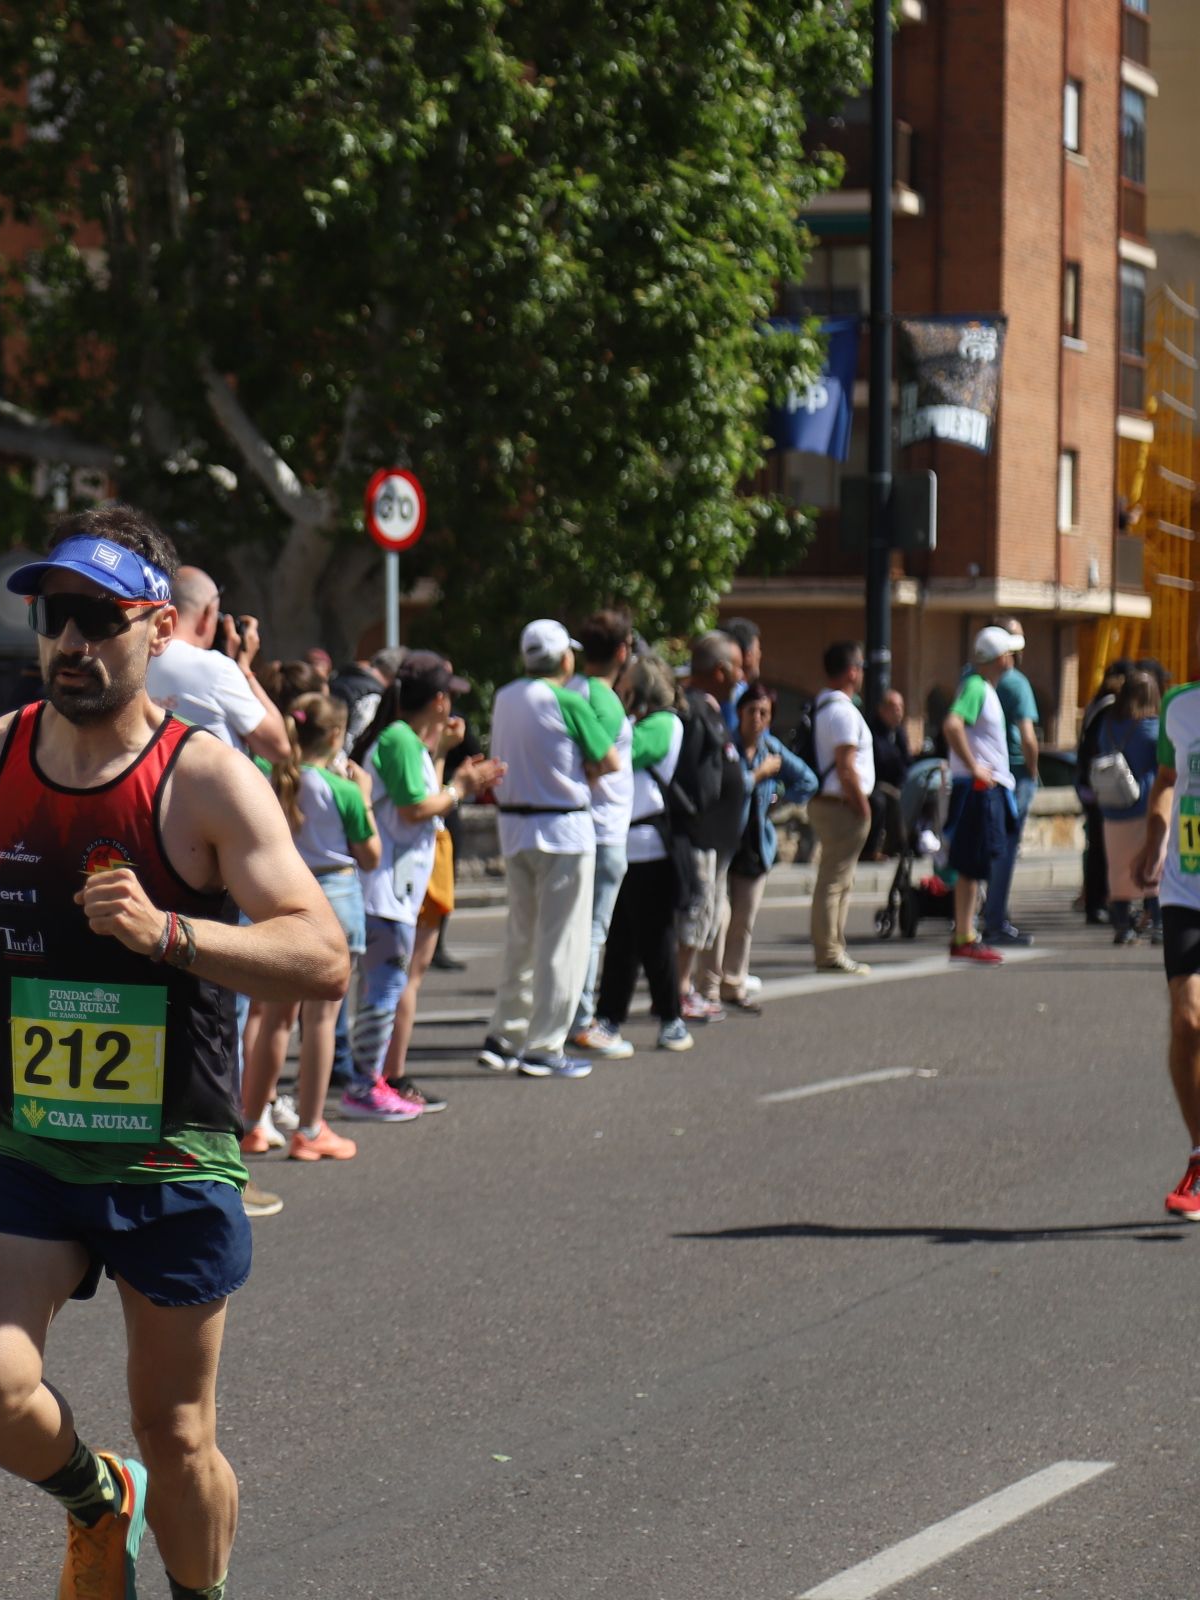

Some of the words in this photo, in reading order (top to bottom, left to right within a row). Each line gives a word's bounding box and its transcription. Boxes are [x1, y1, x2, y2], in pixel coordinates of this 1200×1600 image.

[49, 1000, 76, 1012] CAJA
[79, 1002, 120, 1014] RURAL
[59, 1012, 87, 1020] ZAMORA
[24, 1025, 131, 1091] 212
[48, 1110, 87, 1128] CAJA
[91, 1114, 152, 1130] RURAL
